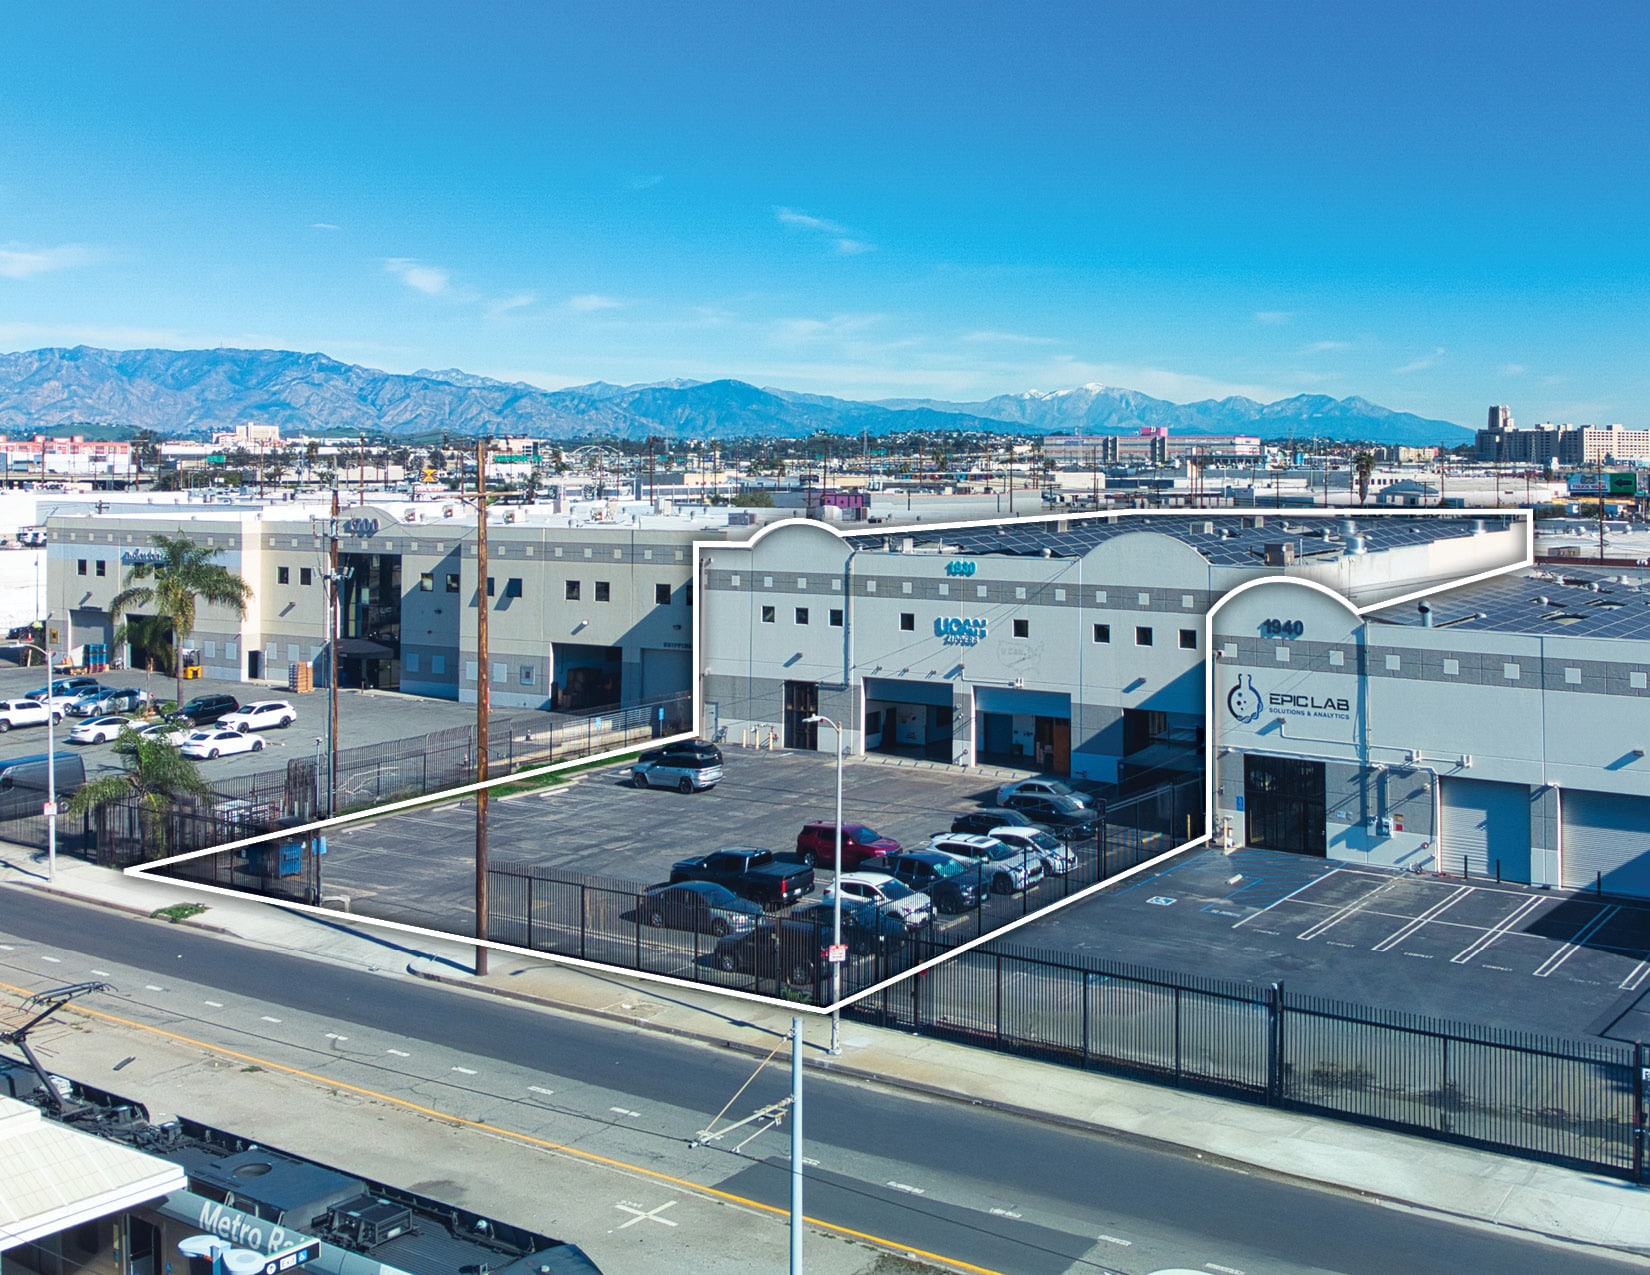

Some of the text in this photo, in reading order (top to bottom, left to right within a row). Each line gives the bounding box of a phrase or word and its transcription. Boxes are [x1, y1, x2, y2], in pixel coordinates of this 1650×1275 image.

[934, 616, 988, 639] UCAN
[1263, 618, 1304, 636] 1940
[1269, 693, 1349, 711] EPIC LAB
[1268, 707, 1305, 716] SOLUTIONS
[1313, 711, 1350, 720] ANALYTICS
[199, 1200, 262, 1250] Metro
[281, 1256, 295, 1268] Exit
